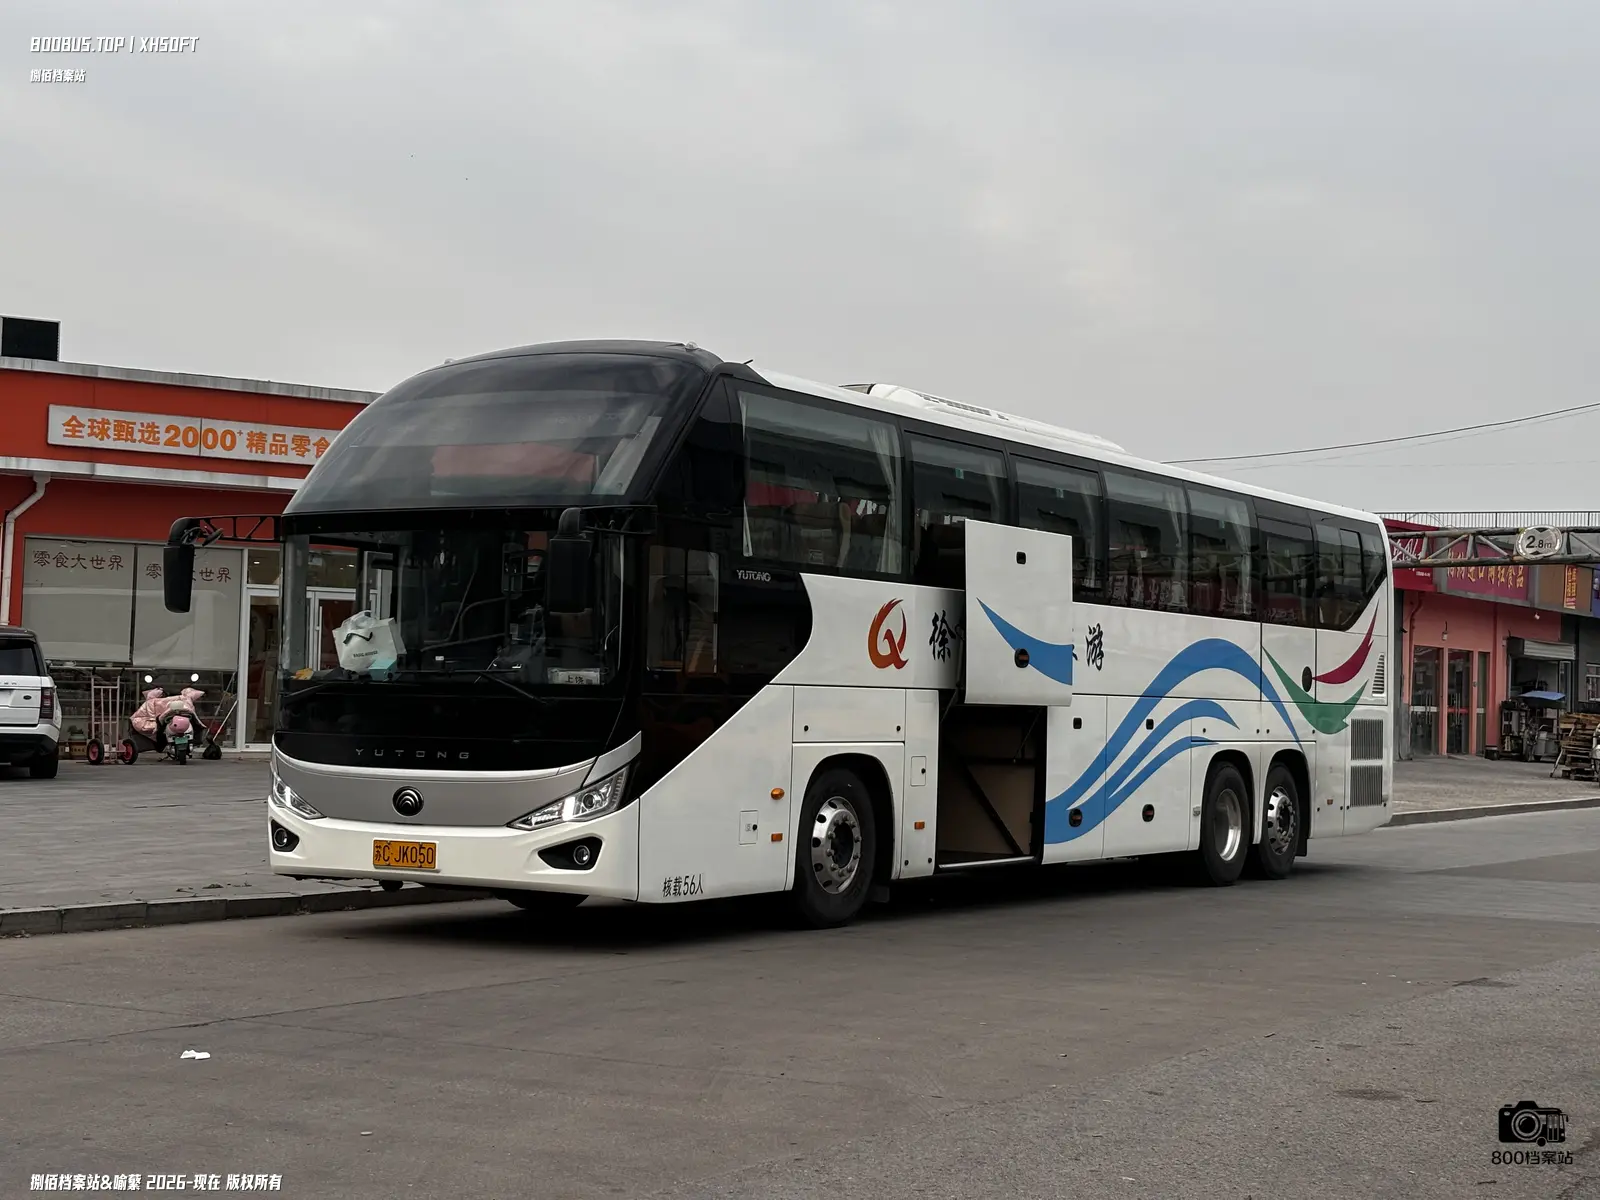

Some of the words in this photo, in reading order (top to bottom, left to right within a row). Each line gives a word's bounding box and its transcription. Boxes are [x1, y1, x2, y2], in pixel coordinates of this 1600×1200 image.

[33, 551, 124, 571] 零食大世界
[736, 570, 772, 582] YUTONG
[355, 748, 470, 760] YUTONG
[662, 873, 704, 898] 核载56人
